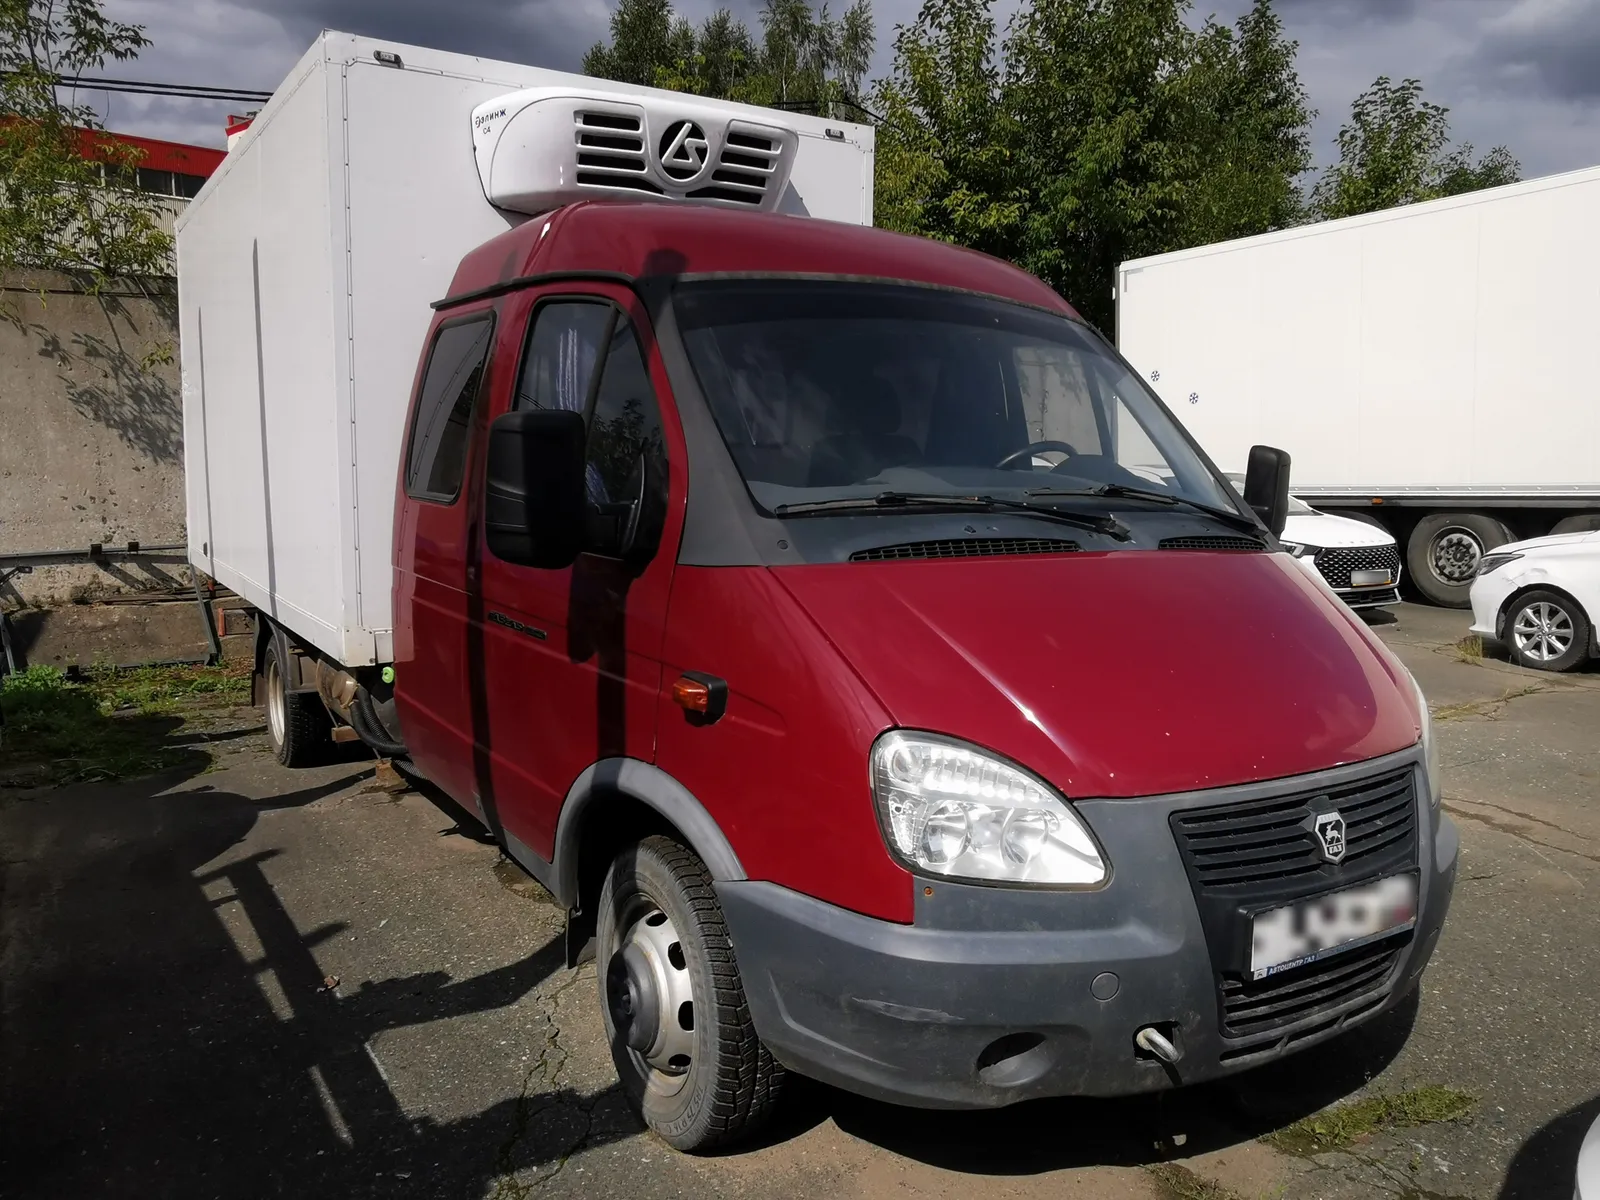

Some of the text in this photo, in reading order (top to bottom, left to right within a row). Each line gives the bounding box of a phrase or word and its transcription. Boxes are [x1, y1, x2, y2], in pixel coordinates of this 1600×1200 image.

[1329, 845, 1342, 854] ГАЗ
[1268, 955, 1315, 975] АВТОЦЕНТР ГАЗ
